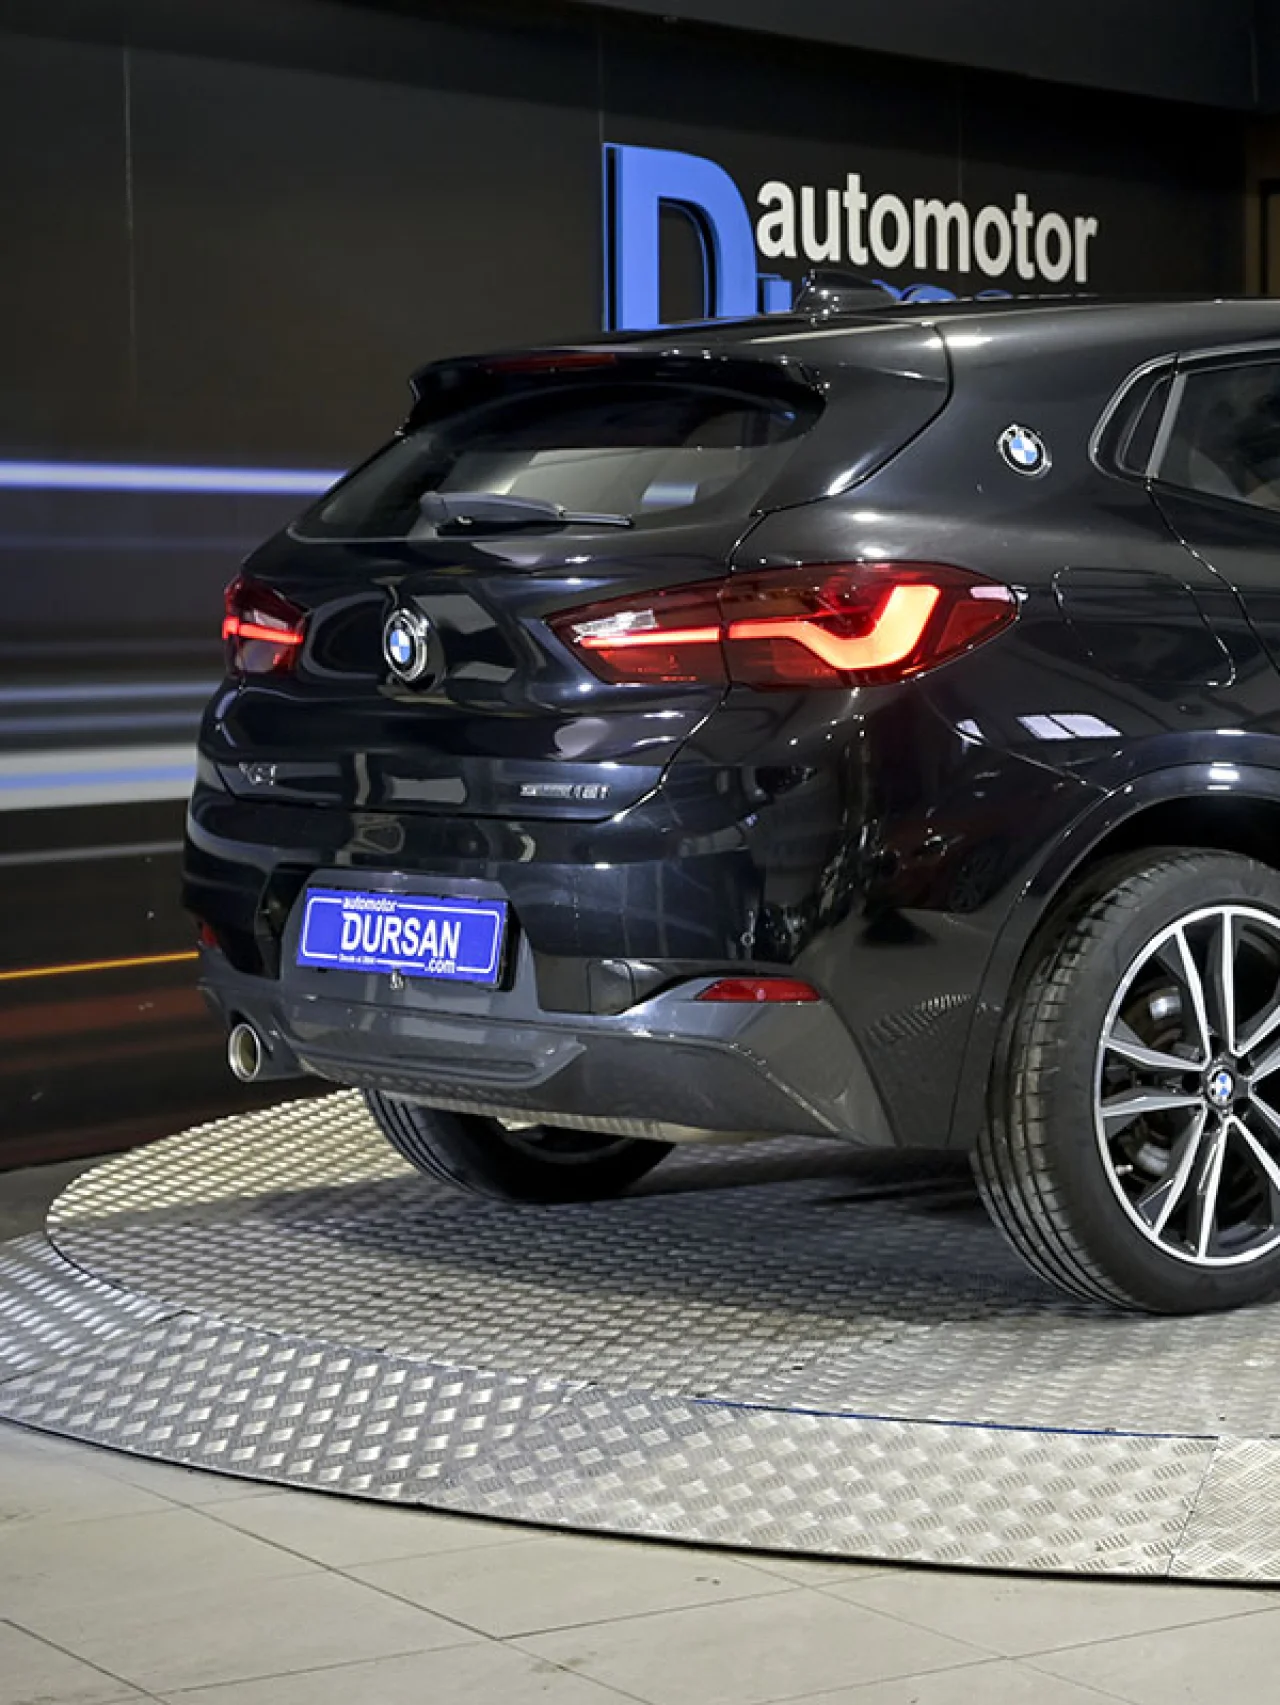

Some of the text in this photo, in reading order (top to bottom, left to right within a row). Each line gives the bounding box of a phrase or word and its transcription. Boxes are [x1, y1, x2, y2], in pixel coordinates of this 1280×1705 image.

[756, 173, 1098, 283] automotor
[342, 896, 398, 912] automotor
[340, 911, 462, 959] DURSAN
[424, 958, 456, 974] .com
